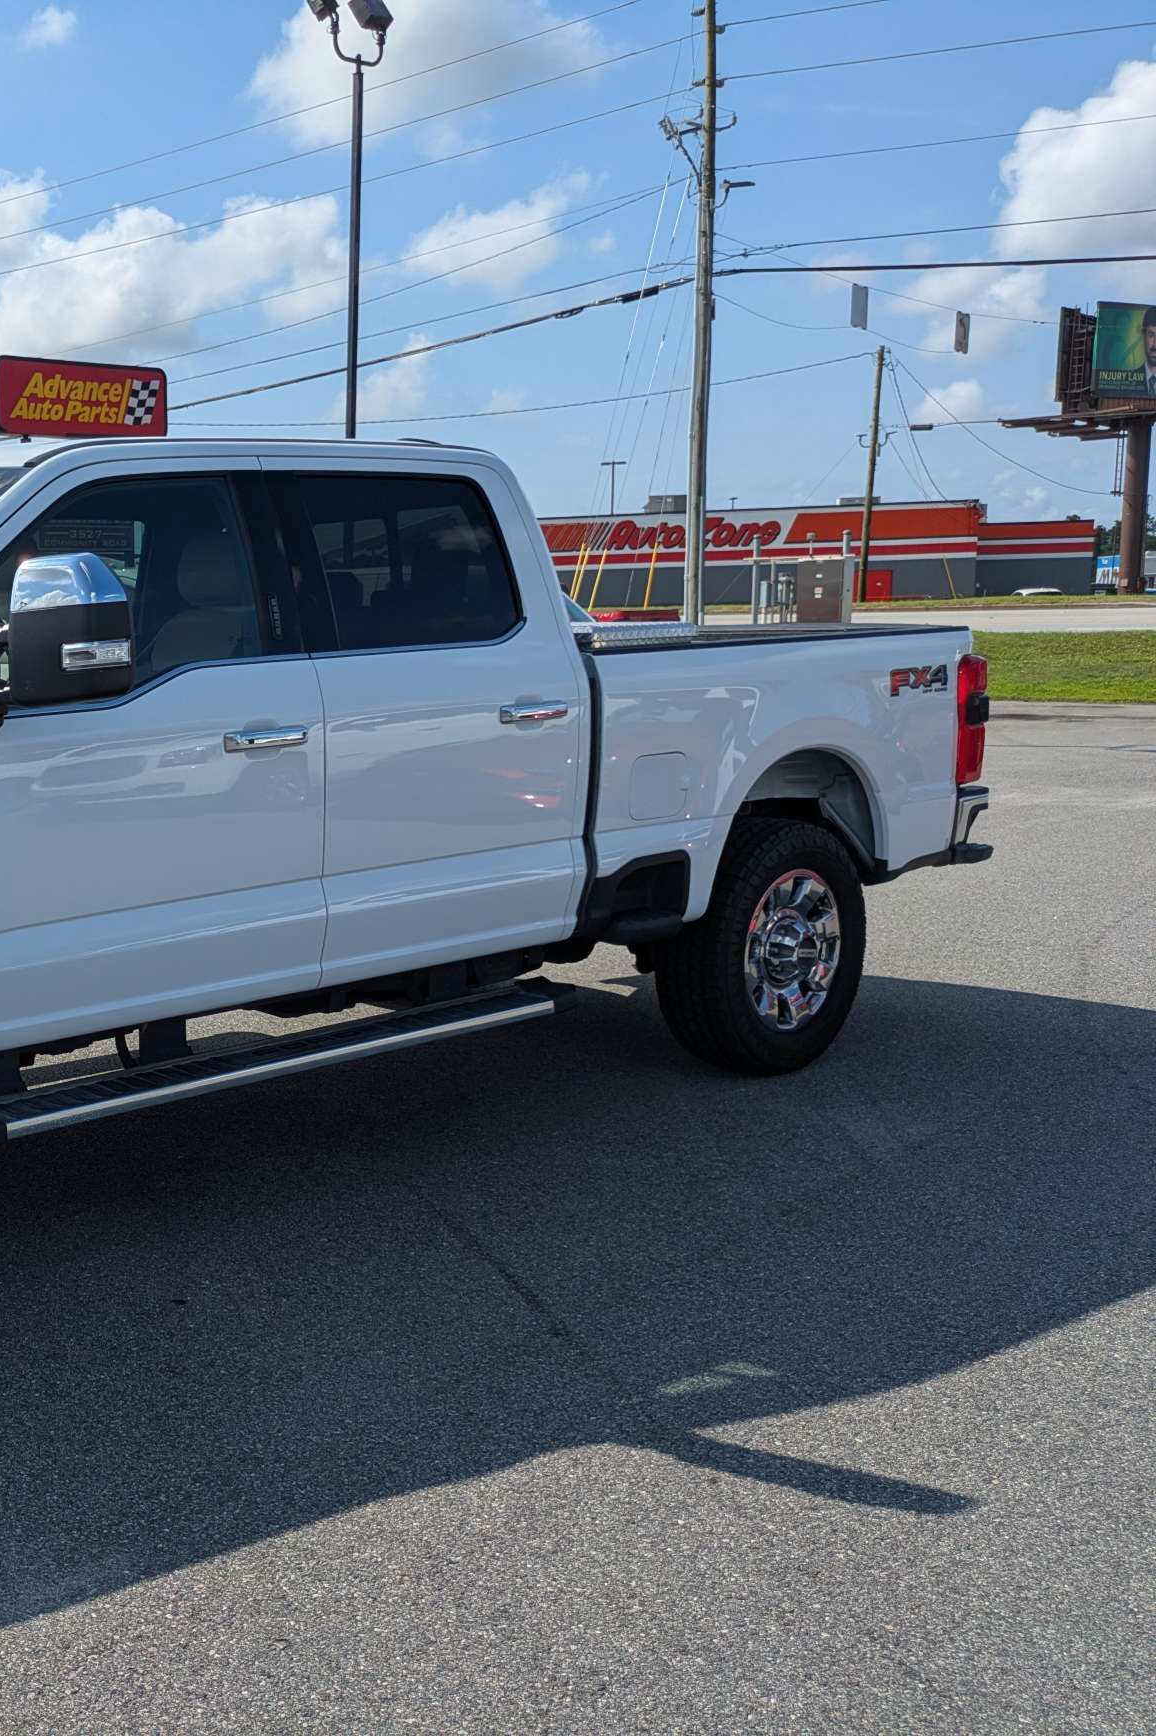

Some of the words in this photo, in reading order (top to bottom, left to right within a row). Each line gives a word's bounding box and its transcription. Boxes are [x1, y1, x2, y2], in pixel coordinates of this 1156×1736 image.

[22, 372, 122, 402] Advance
[1100, 371, 1127, 382] INJURY
[1128, 372, 1144, 382] LAW
[10, 398, 63, 421] Auto
[64, 401, 118, 424] Parts
[890, 664, 948, 696] FX4
